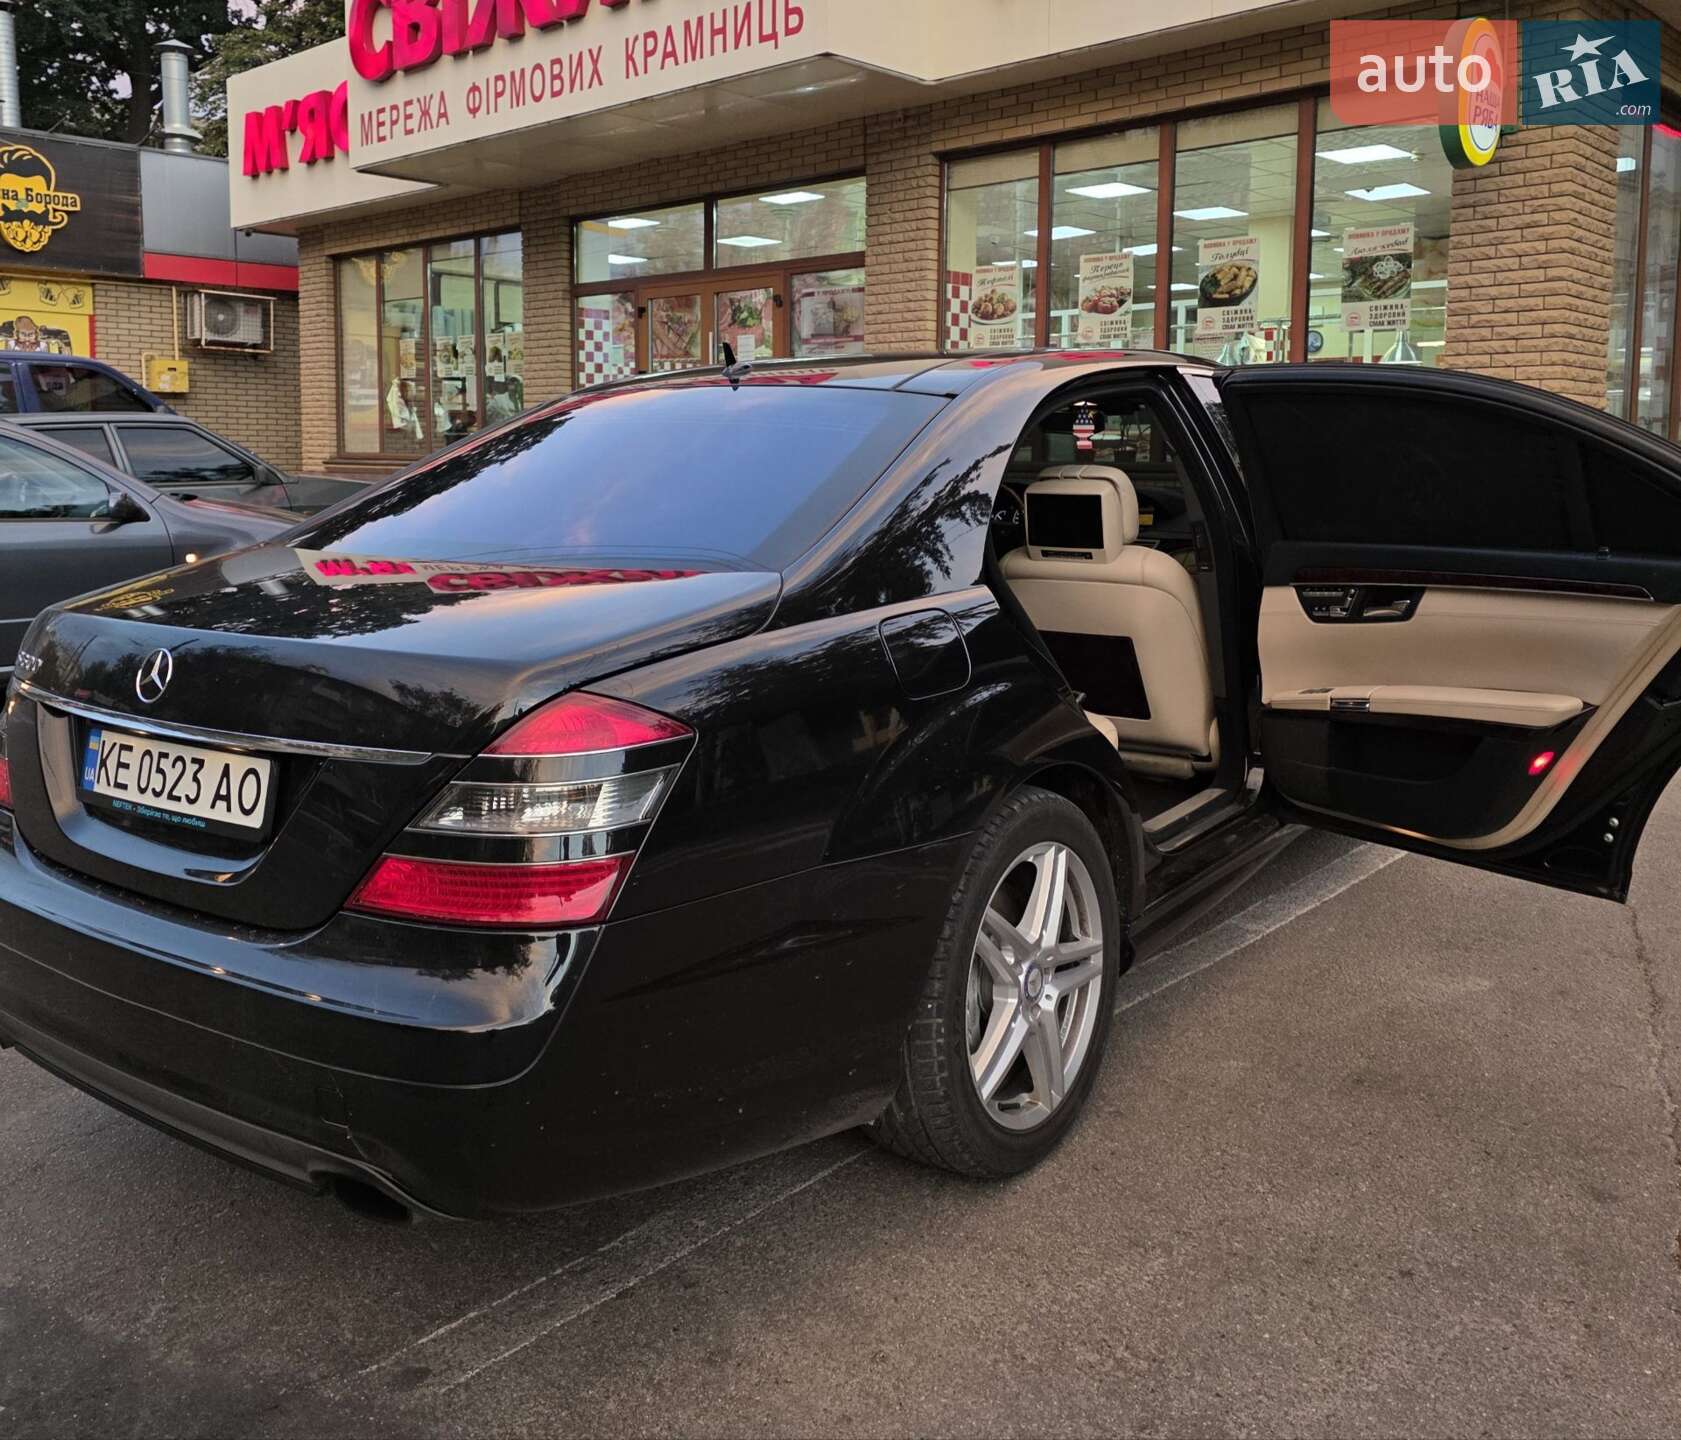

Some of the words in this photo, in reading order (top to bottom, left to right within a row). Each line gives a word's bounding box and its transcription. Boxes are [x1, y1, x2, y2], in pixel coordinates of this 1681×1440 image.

[360, 90, 450, 147] МЕРЕЖА
[466, 45, 604, 120] ФІРМОВИХ
[625, 0, 804, 79] КРАМНИЦЬ
[25, 187, 79, 208] Борода
[84, 767, 95, 781] UA
[97, 740, 134, 790] KE
[137, 749, 206, 805] 0523
[210, 763, 262, 816] AO
